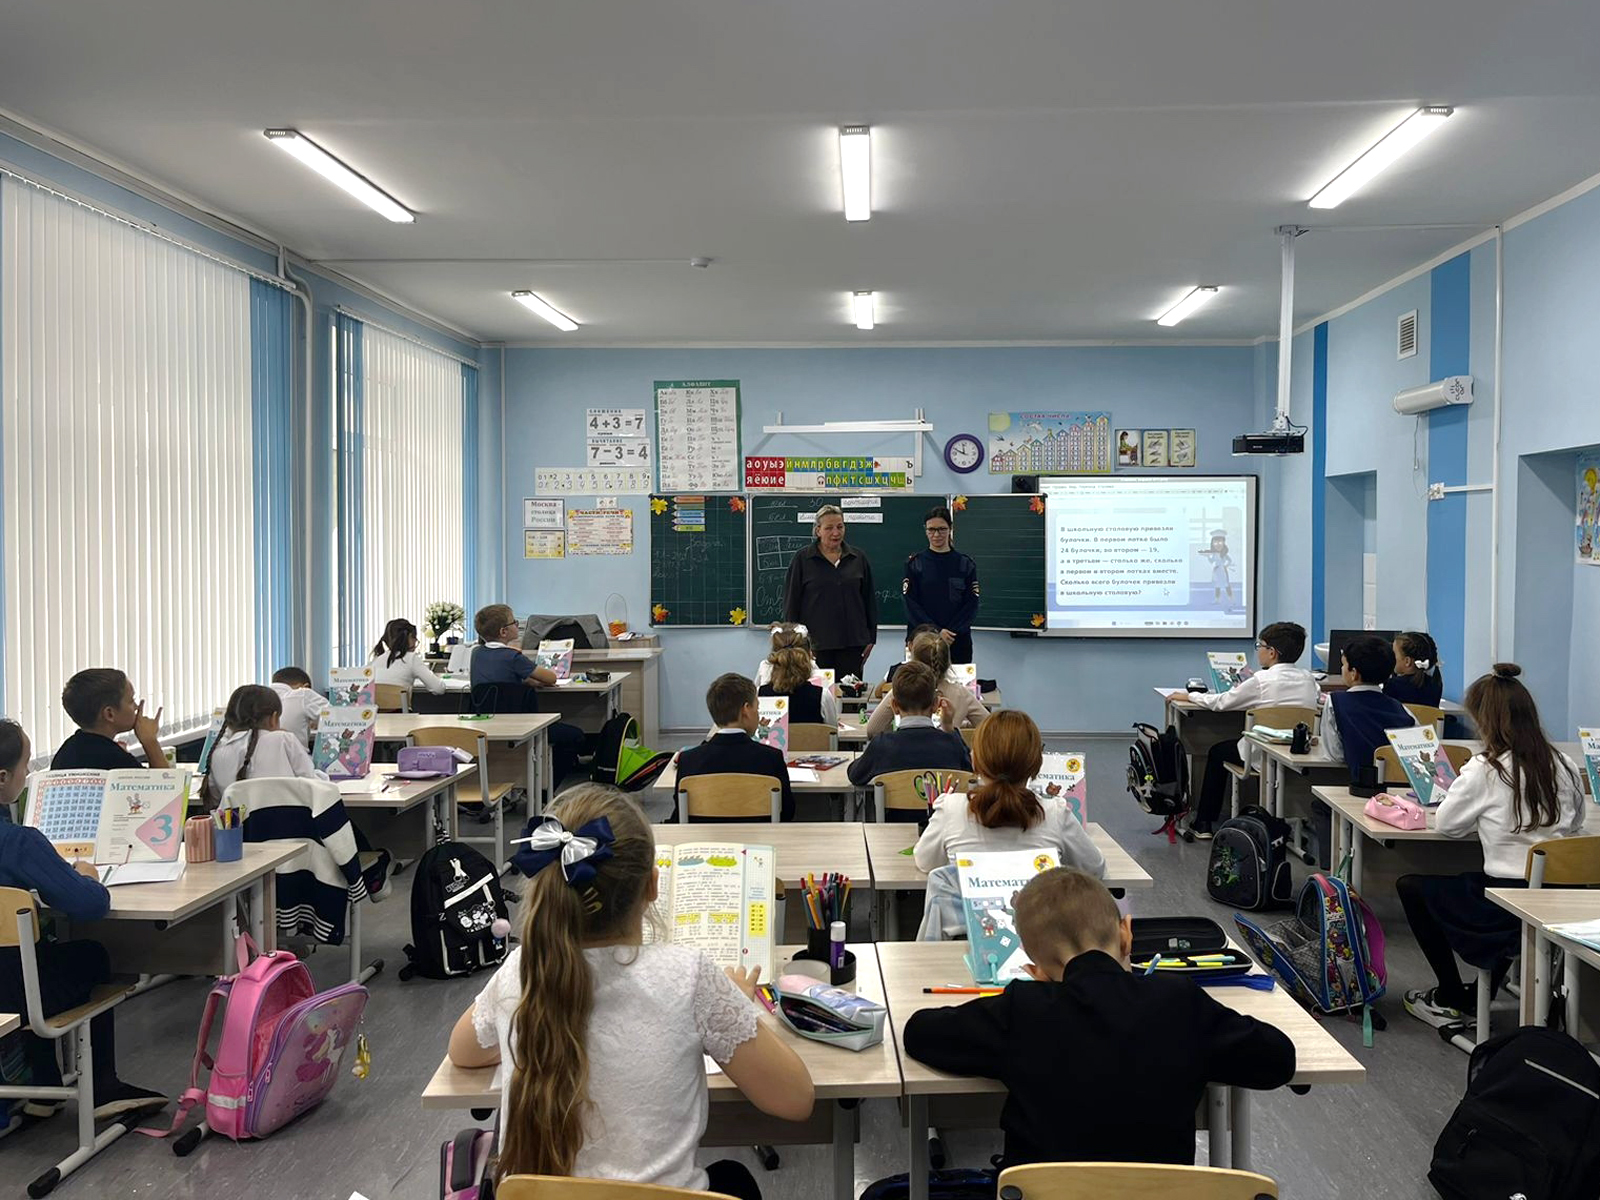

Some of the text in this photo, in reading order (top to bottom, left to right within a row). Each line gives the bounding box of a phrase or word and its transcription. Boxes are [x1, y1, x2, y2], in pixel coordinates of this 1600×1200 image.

[590, 417, 598, 429] 4
[613, 417, 620, 429] 3
[635, 417, 643, 429] 7
[591, 447, 600, 459] 7
[615, 447, 623, 459] 3
[639, 446, 648, 459] 4
[150, 814, 172, 842] 3
